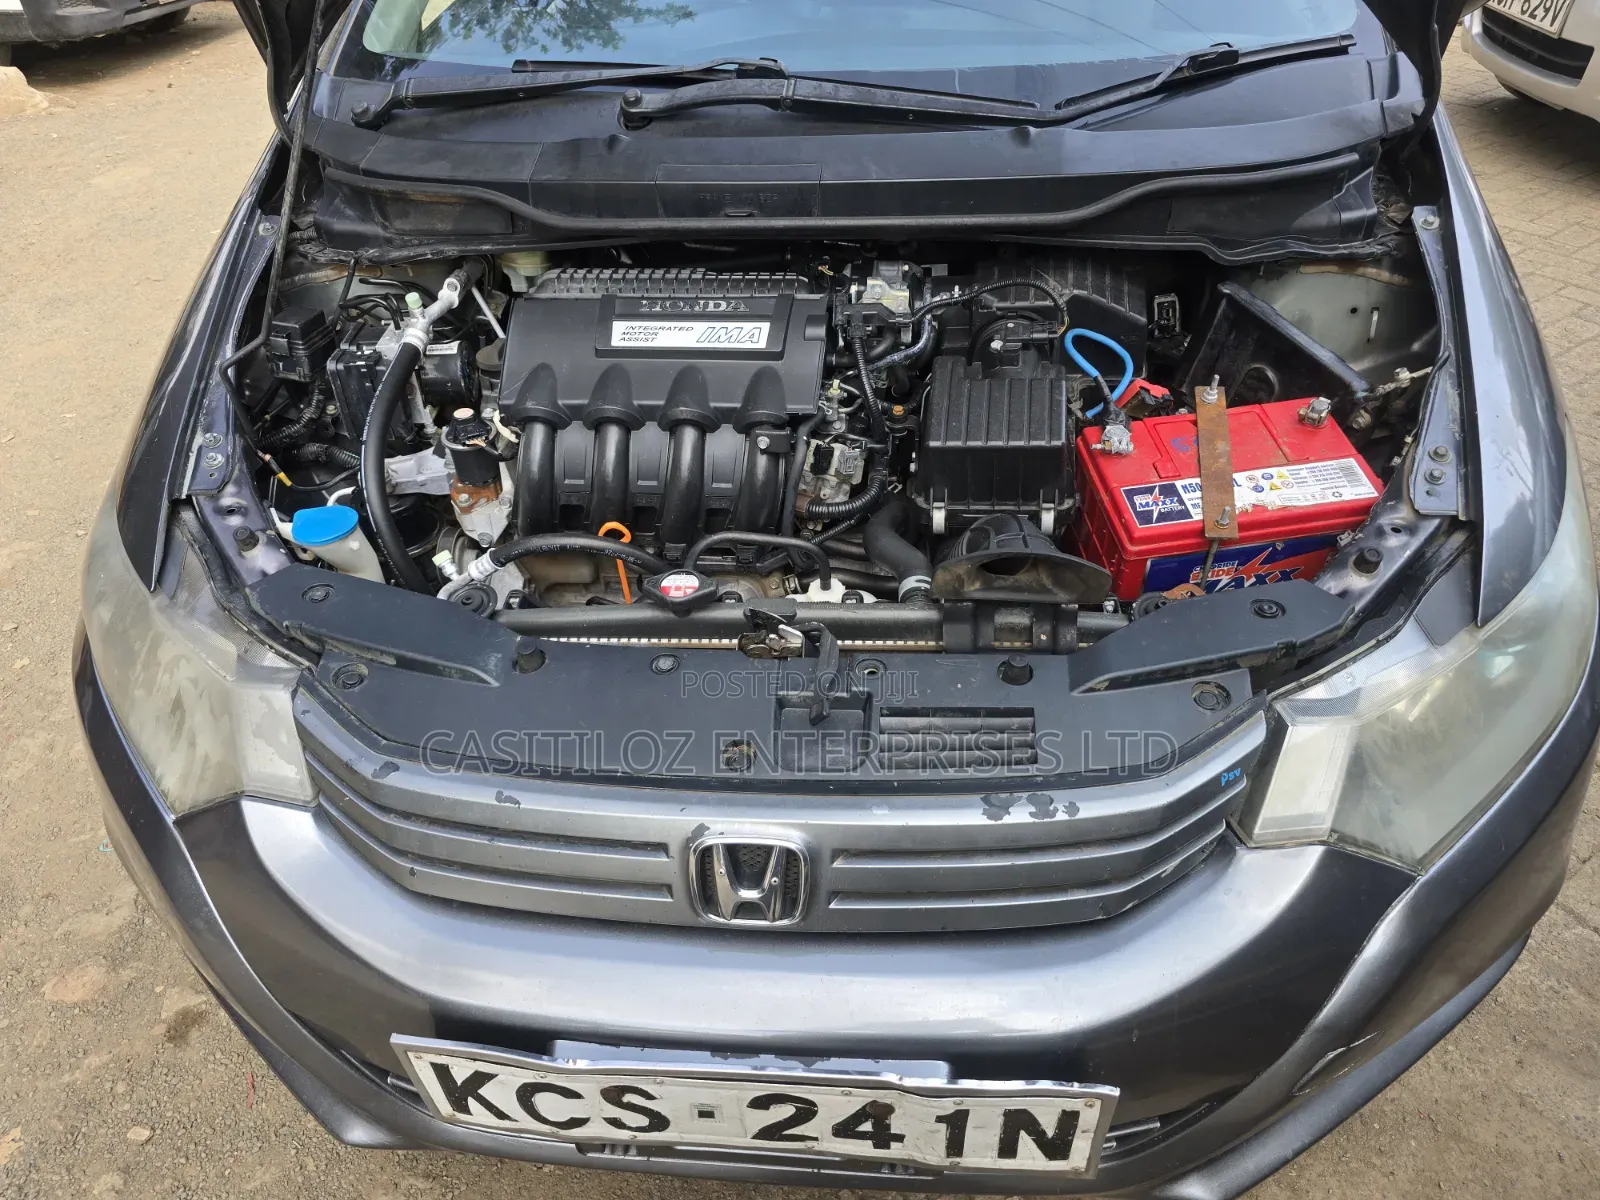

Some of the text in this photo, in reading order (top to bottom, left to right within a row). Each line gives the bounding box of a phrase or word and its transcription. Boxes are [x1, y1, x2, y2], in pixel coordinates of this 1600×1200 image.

[639, 300, 749, 312] HONDA
[696, 326, 762, 344] IMA
[1137, 496, 1178, 511] MAXX
[1160, 505, 1185, 513] BATTERY
[429, 1062, 1082, 1162] KCS 241N
